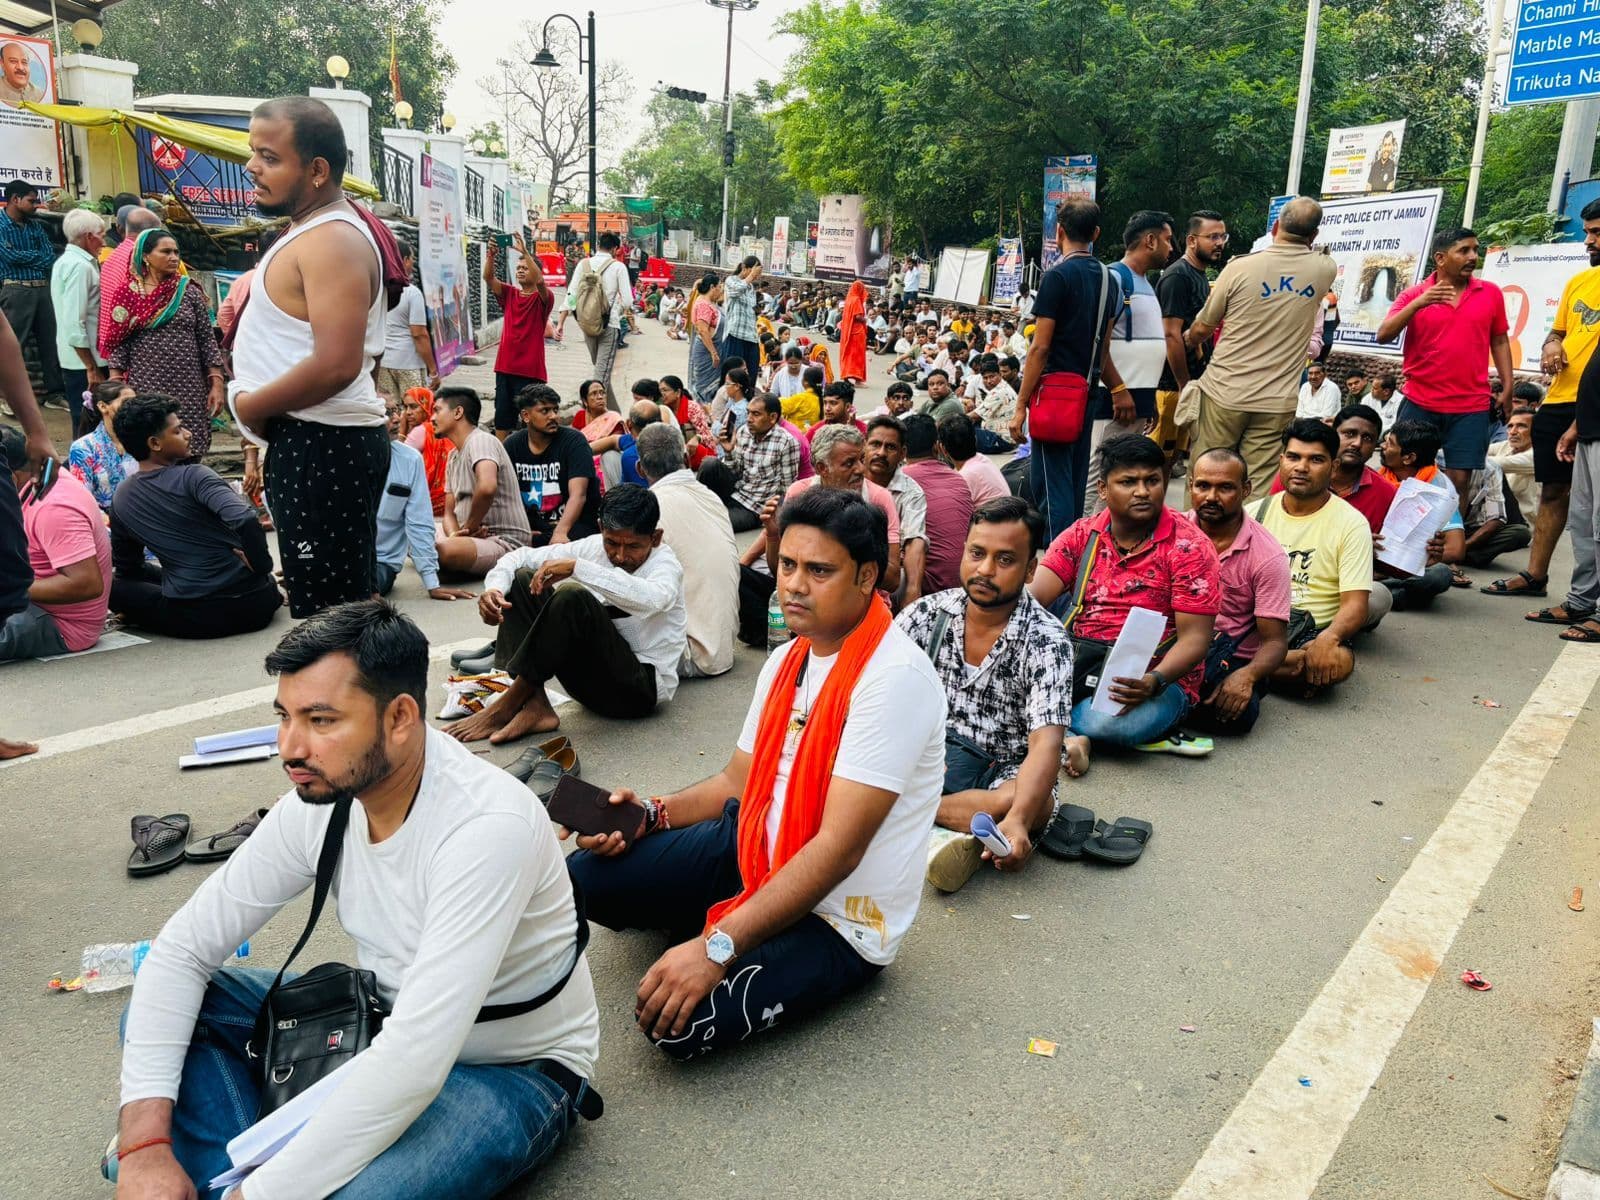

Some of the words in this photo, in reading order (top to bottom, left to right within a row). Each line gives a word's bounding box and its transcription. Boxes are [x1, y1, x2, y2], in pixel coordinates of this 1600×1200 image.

[1524, 0, 1577, 23] Channi
[1583, 0, 1600, 13] Hi
[1518, 33, 1573, 56] Marble
[1514, 72, 1572, 92] Trikuta
[182, 186, 211, 203] FREE
[1320, 213, 1342, 226] AFFIC
[1343, 210, 1372, 224] POLICE
[1373, 208, 1392, 222] CITY
[1394, 206, 1427, 220] JAMMU
[1341, 229, 1364, 237] welcomes
[1362, 240, 1371, 251] JI
[1372, 238, 1400, 251] YATRIS
[1513, 254, 1533, 263] Jammu
[1533, 254, 1559, 264] Municipal
[1545, 297, 1560, 307] Shri
[515, 463, 548, 481] PRIDE
[549, 462, 560, 480] OF
